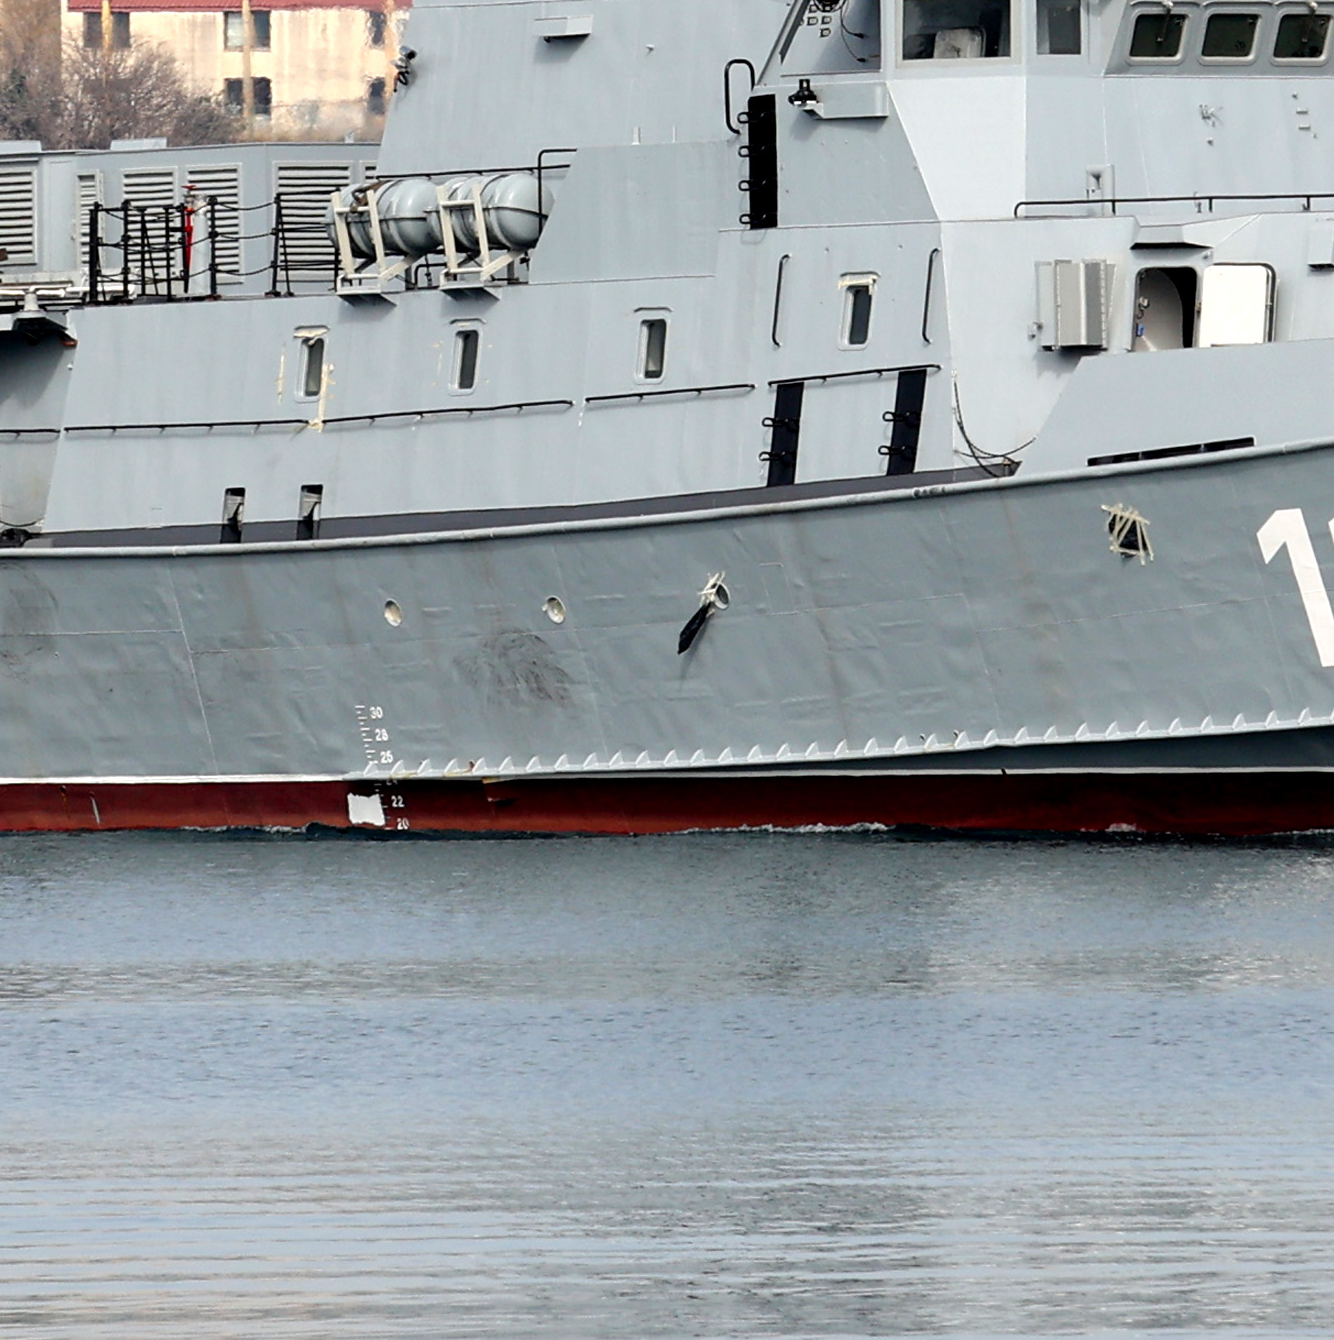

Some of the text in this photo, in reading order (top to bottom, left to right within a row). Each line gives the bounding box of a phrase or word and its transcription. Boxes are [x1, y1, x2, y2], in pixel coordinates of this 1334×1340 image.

[369, 706, 383, 719] 30
[375, 728, 389, 741] 28
[380, 750, 394, 763] 26
[391, 795, 405, 807] 22
[396, 817, 410, 830] 20
